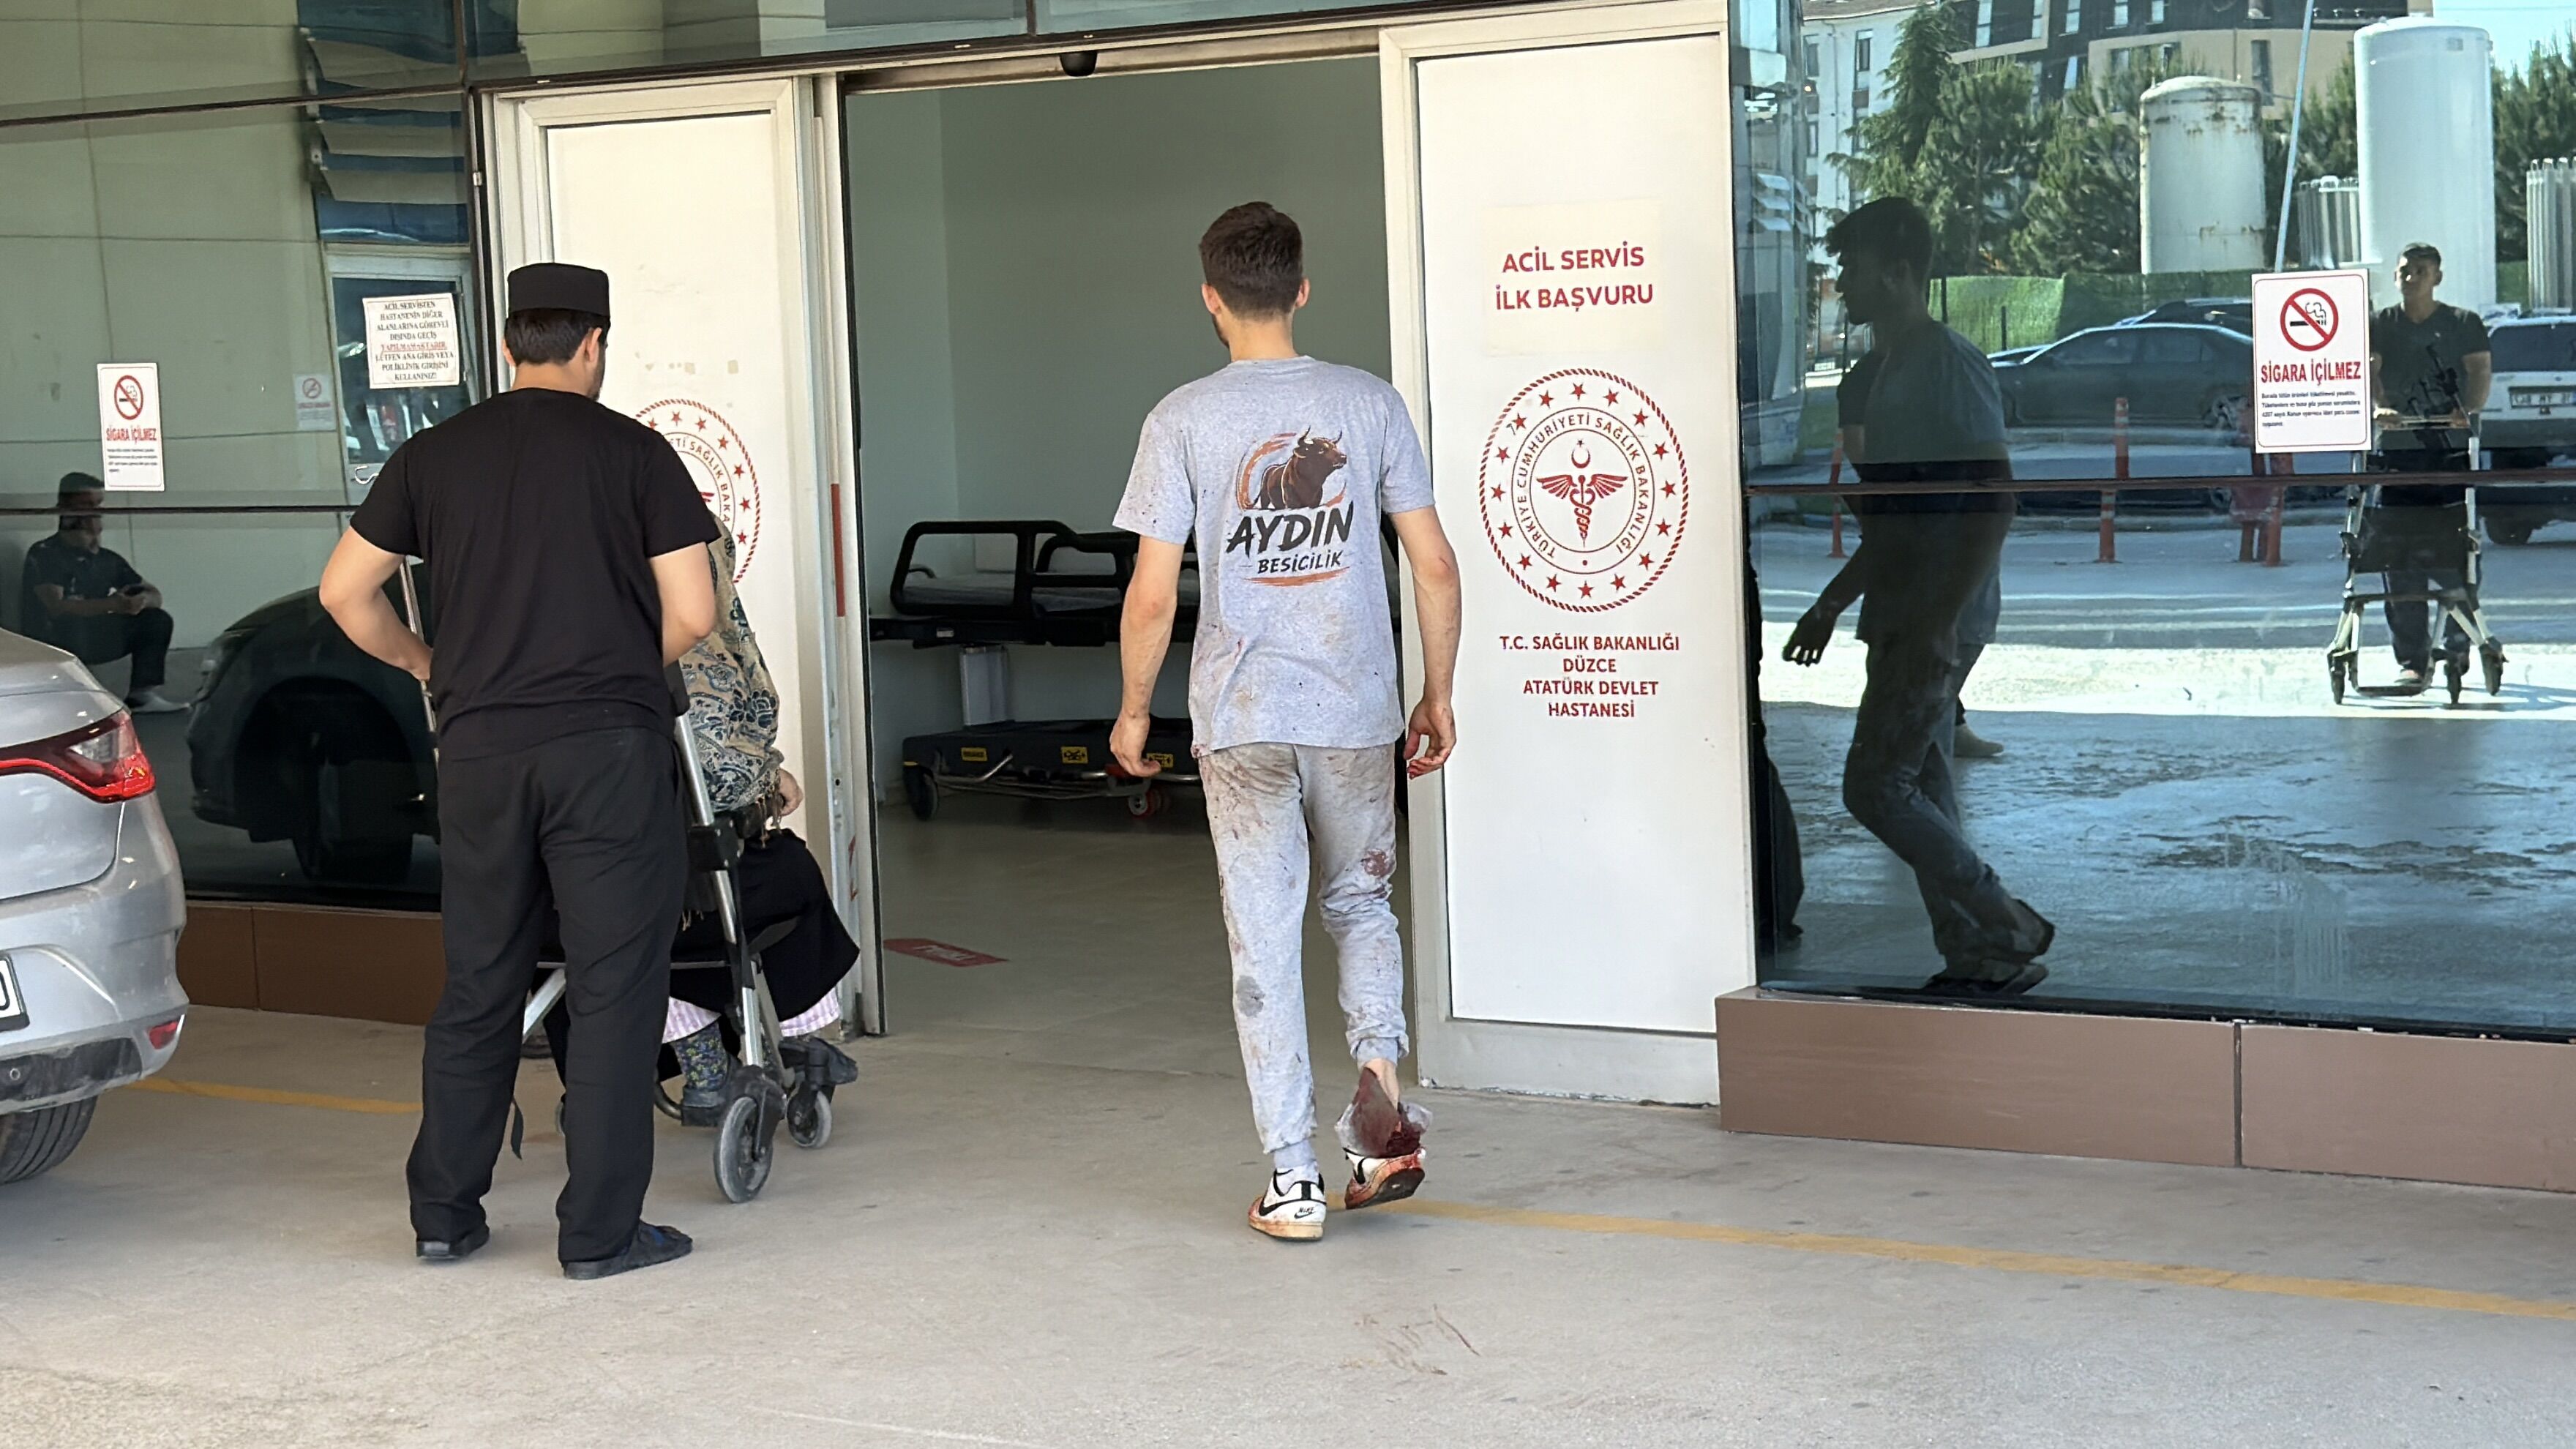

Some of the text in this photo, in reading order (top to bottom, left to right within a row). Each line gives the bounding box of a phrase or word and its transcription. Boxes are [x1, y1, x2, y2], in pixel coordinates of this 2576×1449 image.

[1502, 240, 1644, 273] ACİL SERVİS
[1496, 283, 1653, 312] İLK BAŞVURU
[2261, 358, 2361, 386] SİGARA İÇİLMEZ
[689, 441, 724, 479] SAĞLIK
[1517, 411, 1649, 558] TÜRKİYE CUMHURİYETİ SAĞLIK BAKANLIĞI
[1225, 499, 1354, 558] AYDIN
[1257, 549, 1344, 574] BESİCİLİK
[1499, 632, 1680, 651] T.C. SAĞLIK BAKANLIĞI
[1563, 655, 1617, 673] DÜZCE
[1523, 676, 1659, 695] ATATÜRK DEVLET
[1549, 700, 1634, 717] HASTANESİ
